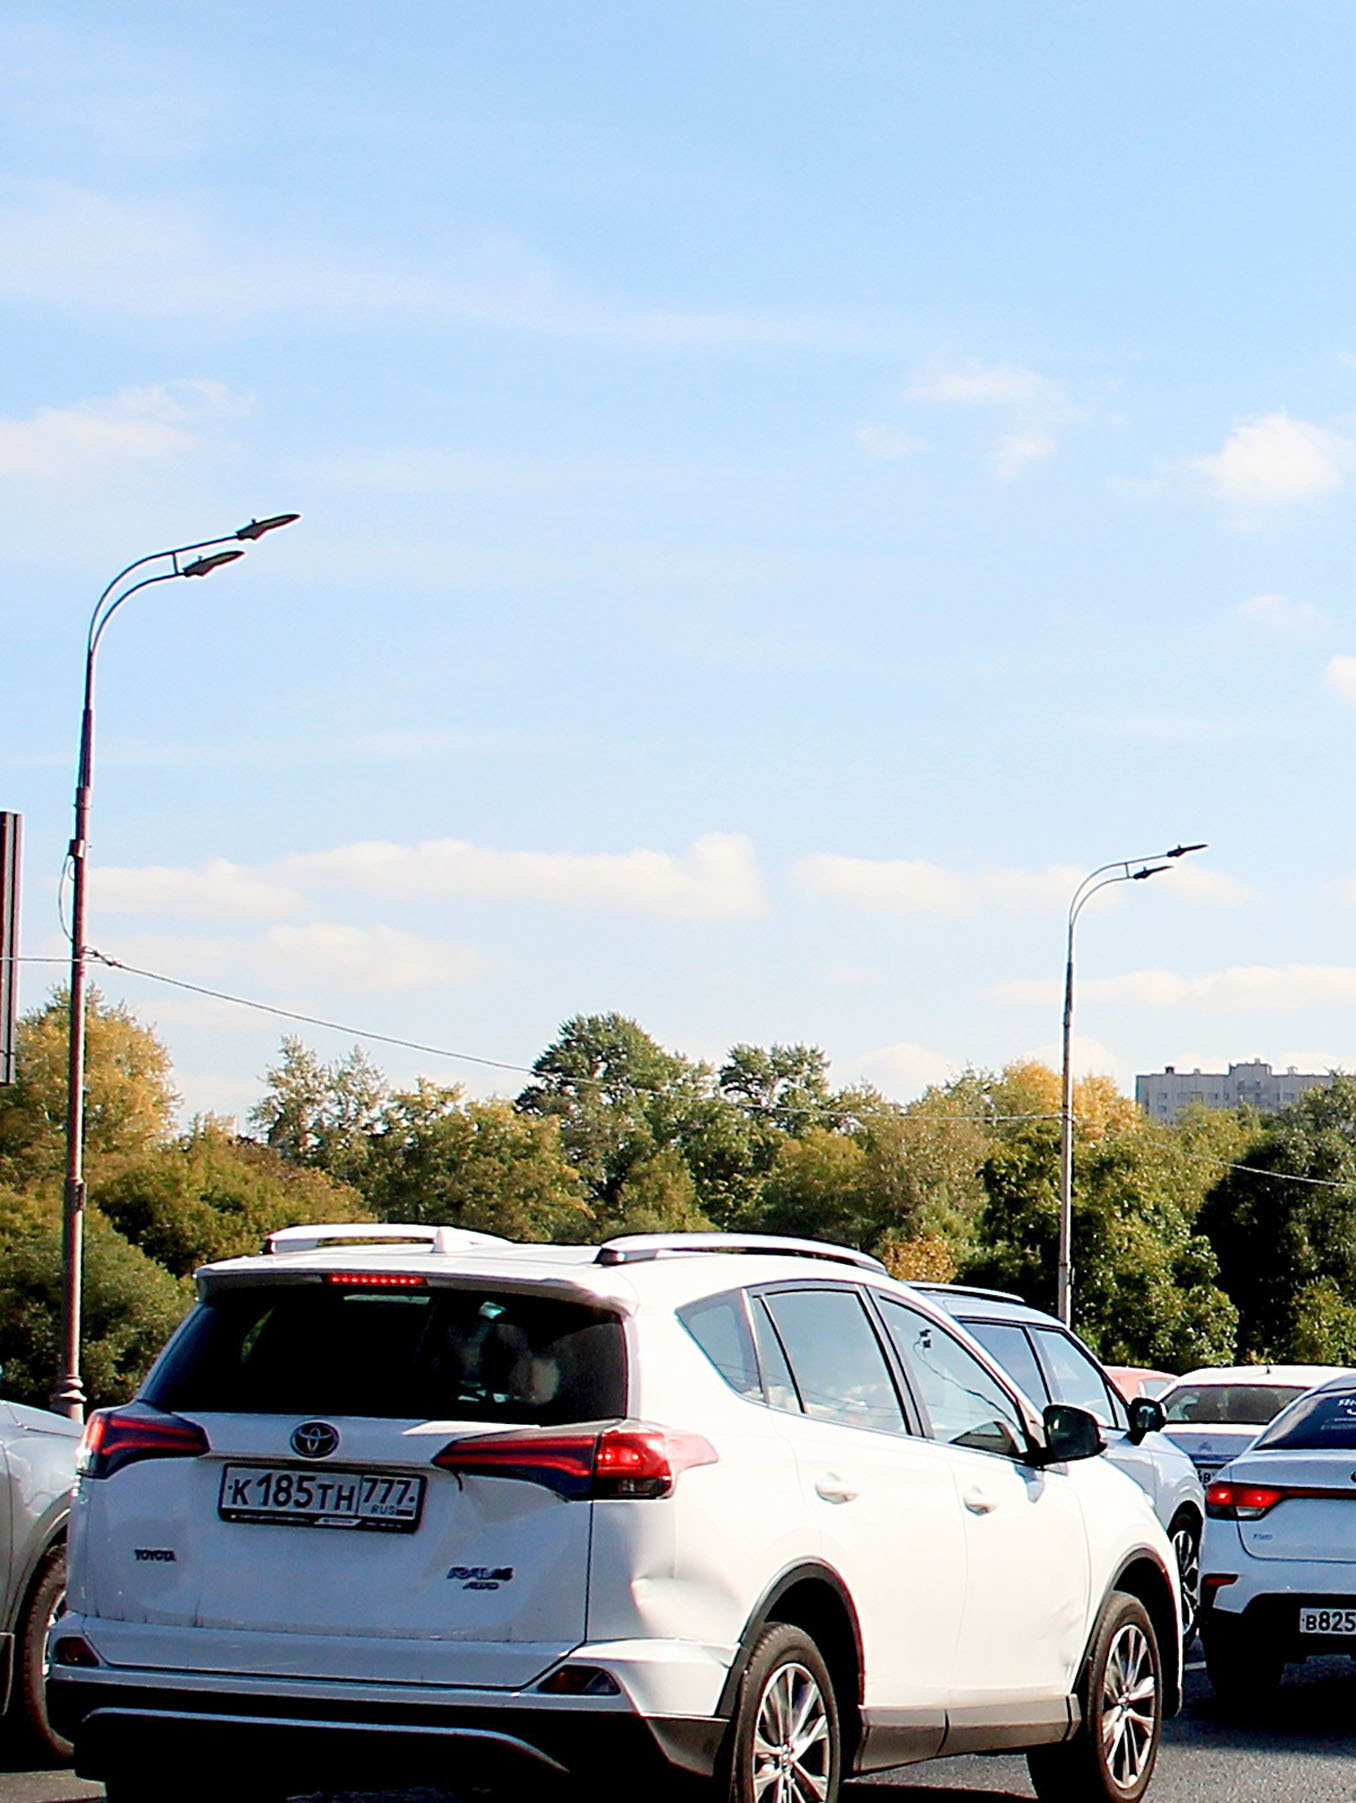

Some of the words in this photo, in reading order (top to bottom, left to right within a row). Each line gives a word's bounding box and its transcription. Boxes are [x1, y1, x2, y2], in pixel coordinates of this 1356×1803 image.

[362, 1477, 412, 1505] 777
[371, 1504, 396, 1516] RUS
[134, 1549, 176, 1562] TOYOTA
